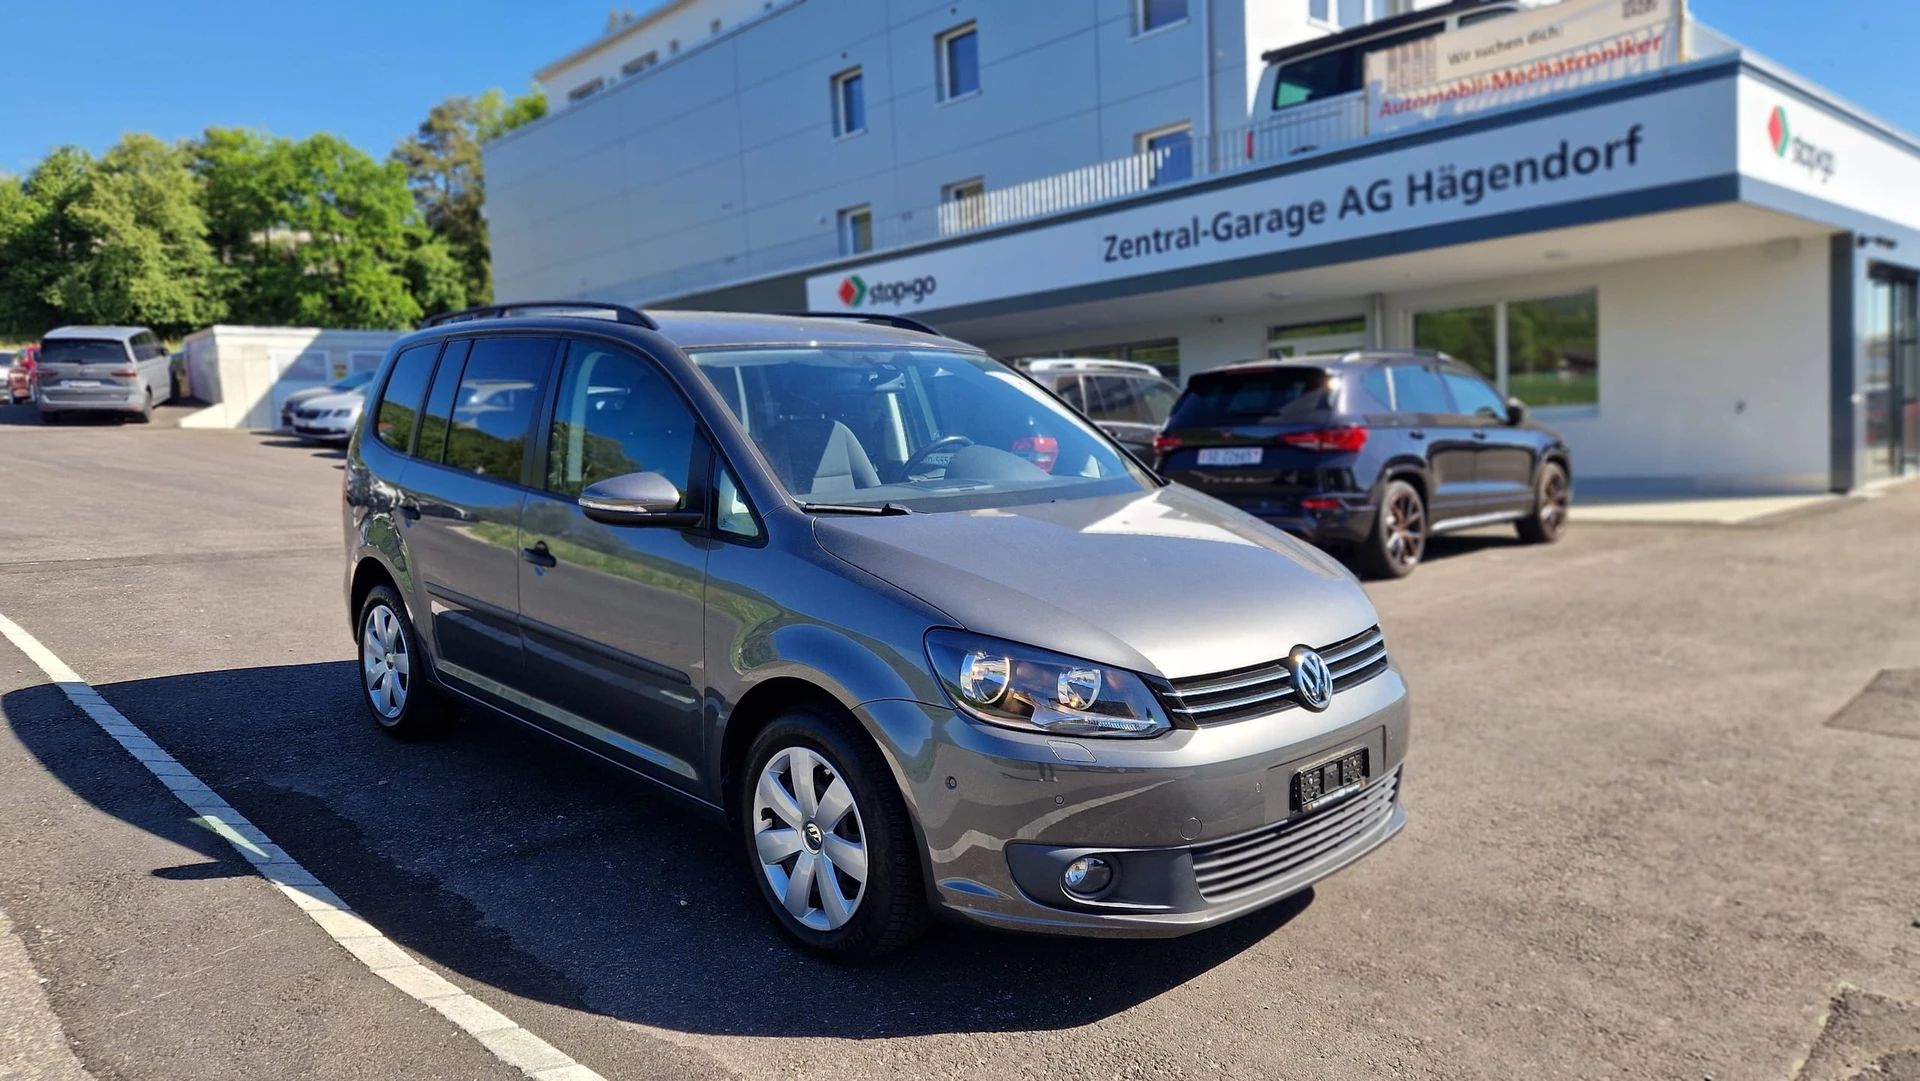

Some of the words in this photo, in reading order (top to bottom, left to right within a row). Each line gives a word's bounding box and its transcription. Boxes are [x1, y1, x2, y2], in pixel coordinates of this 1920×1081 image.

[1447, 51, 1471, 66] Wir
[1474, 36, 1525, 60] suchen
[1103, 199, 1327, 263] Zentral-Garage
[1338, 178, 1393, 221] AG
[1406, 123, 1643, 207] Hägendorf
